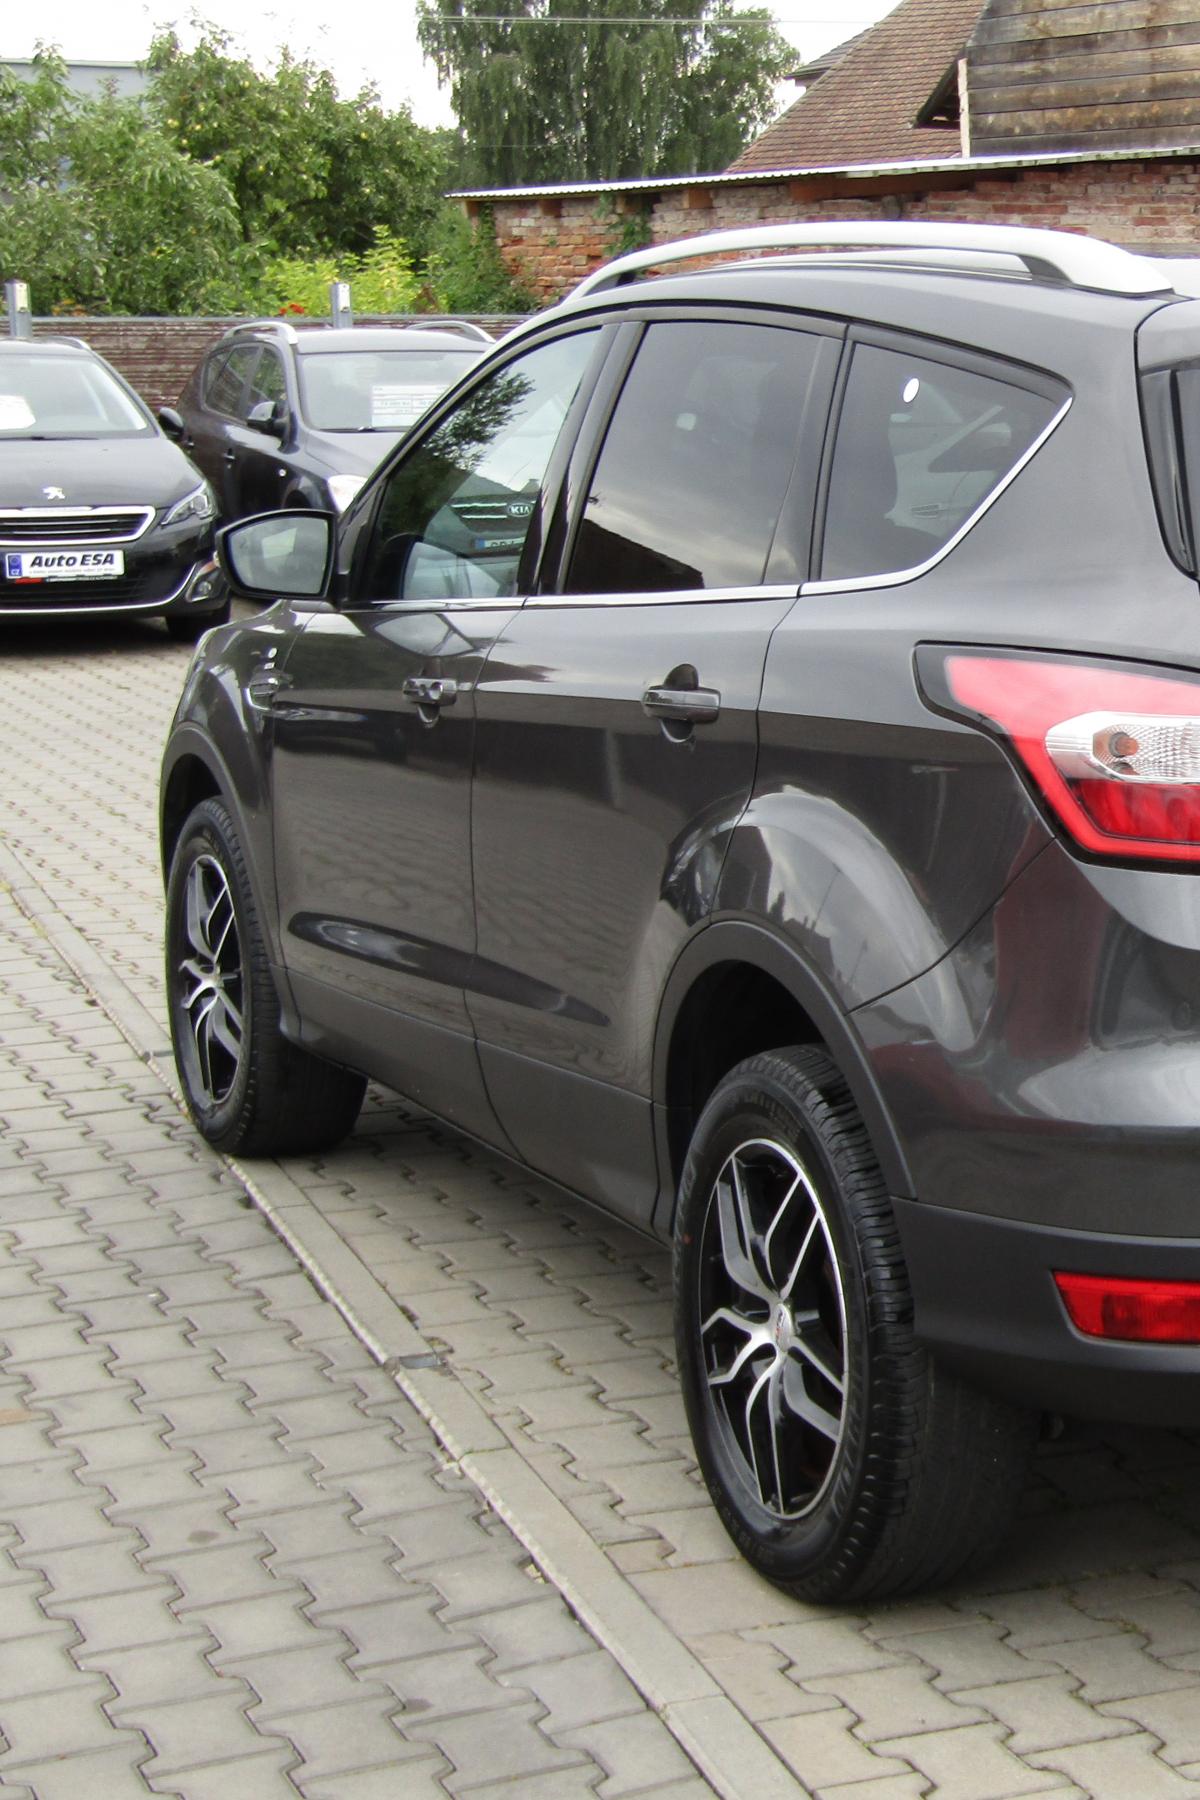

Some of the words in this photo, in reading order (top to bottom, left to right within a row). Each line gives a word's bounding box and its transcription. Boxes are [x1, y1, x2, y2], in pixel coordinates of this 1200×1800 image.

[510, 505, 533, 514] KIA
[30, 555, 77, 568] Auto
[80, 553, 115, 566] ESA
